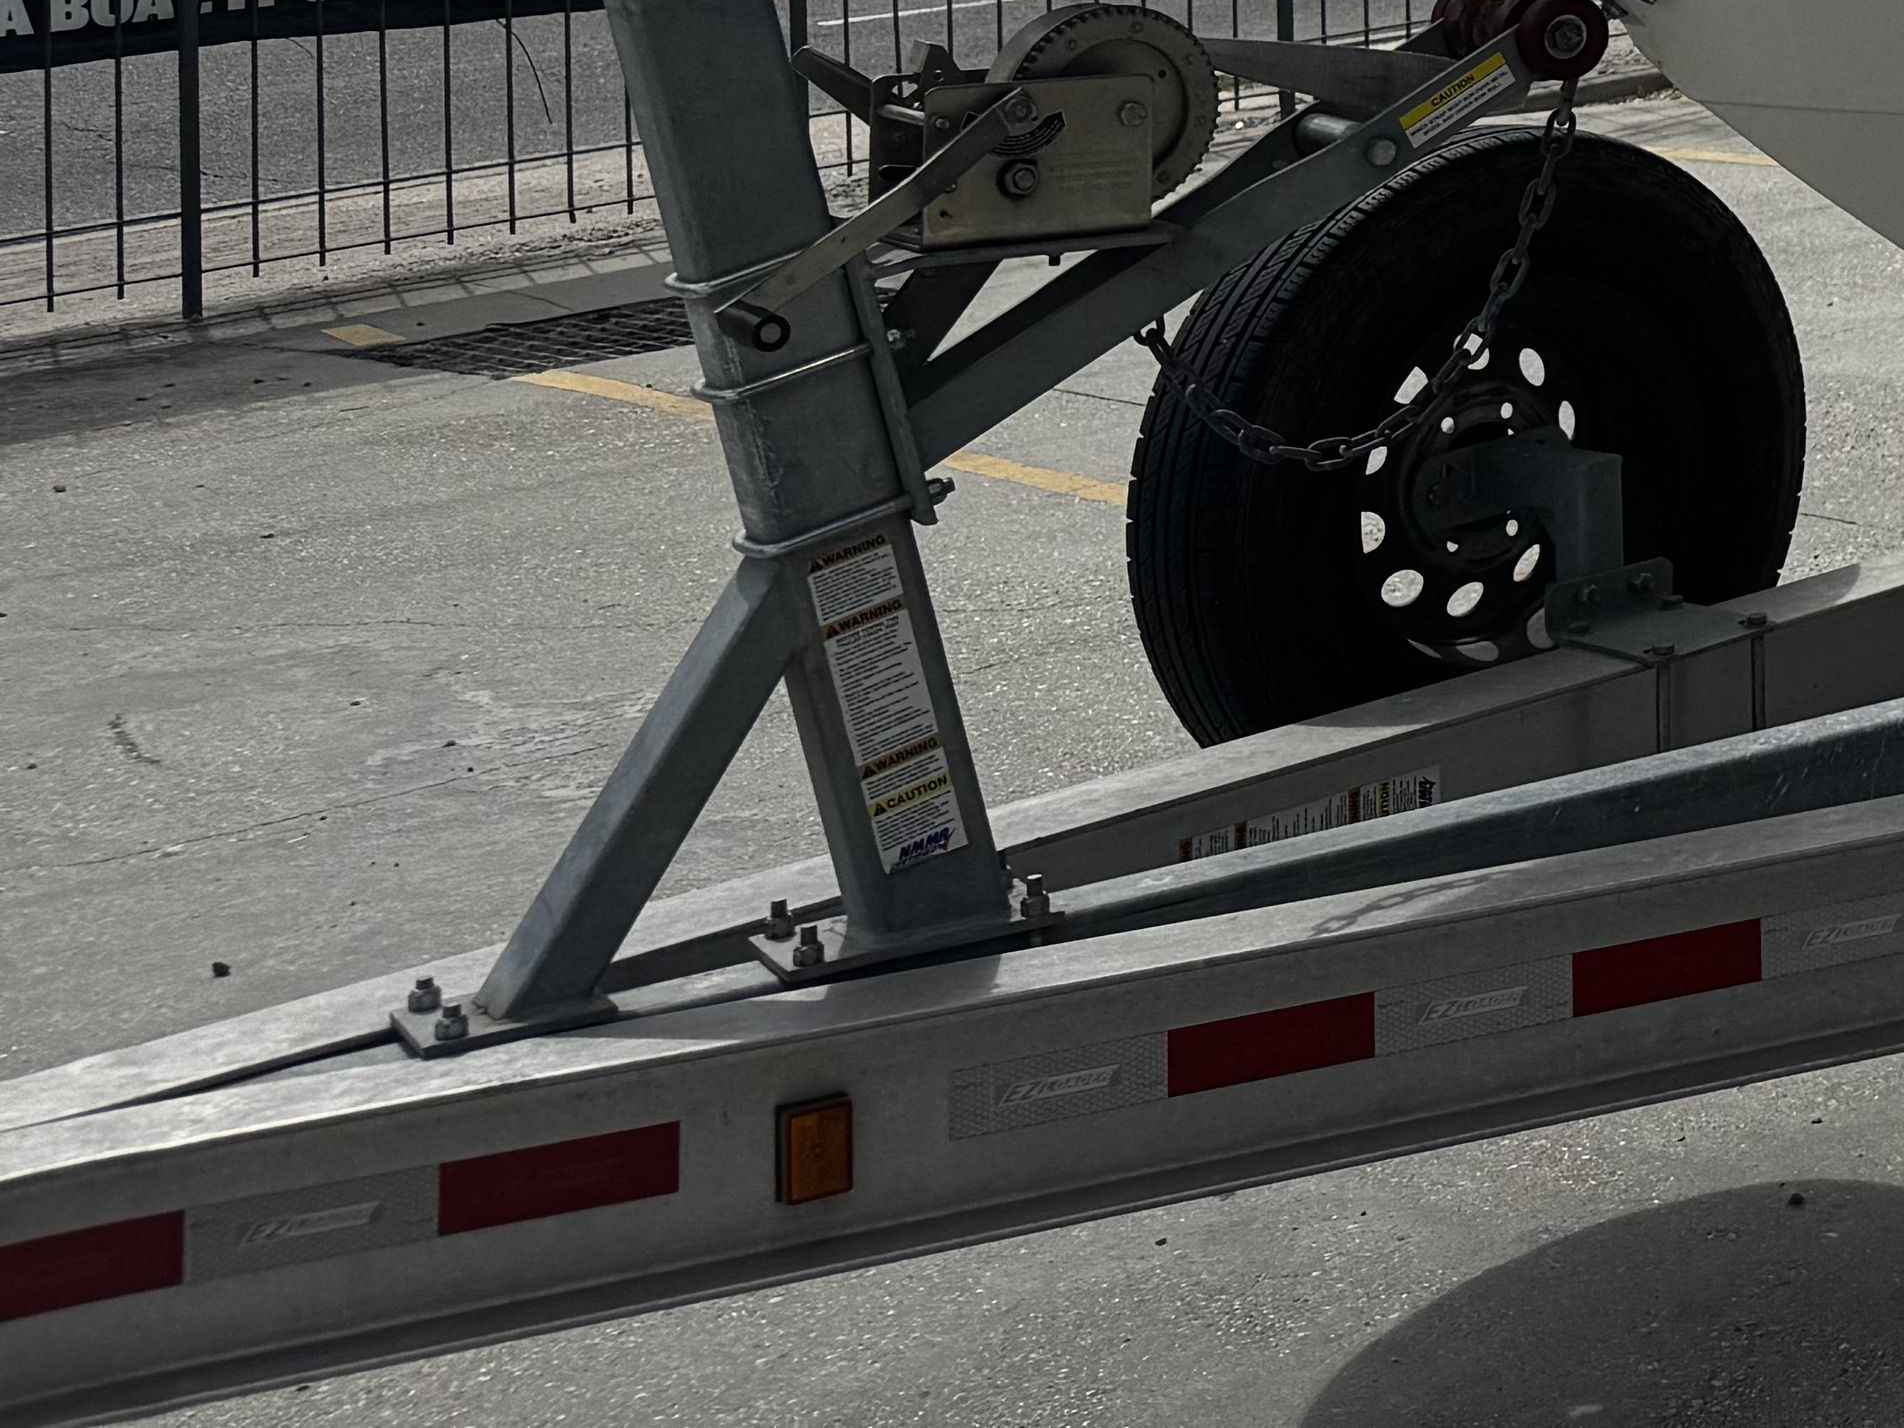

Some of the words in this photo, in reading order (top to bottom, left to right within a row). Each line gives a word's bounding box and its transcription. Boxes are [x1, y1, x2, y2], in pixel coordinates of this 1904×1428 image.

[1431, 74, 1475, 107] CAUTION
[822, 534, 886, 566] WARNING
[840, 599, 902, 630] WARNING
[876, 737, 938, 770] WARNING
[887, 774, 948, 808] CAUTION
